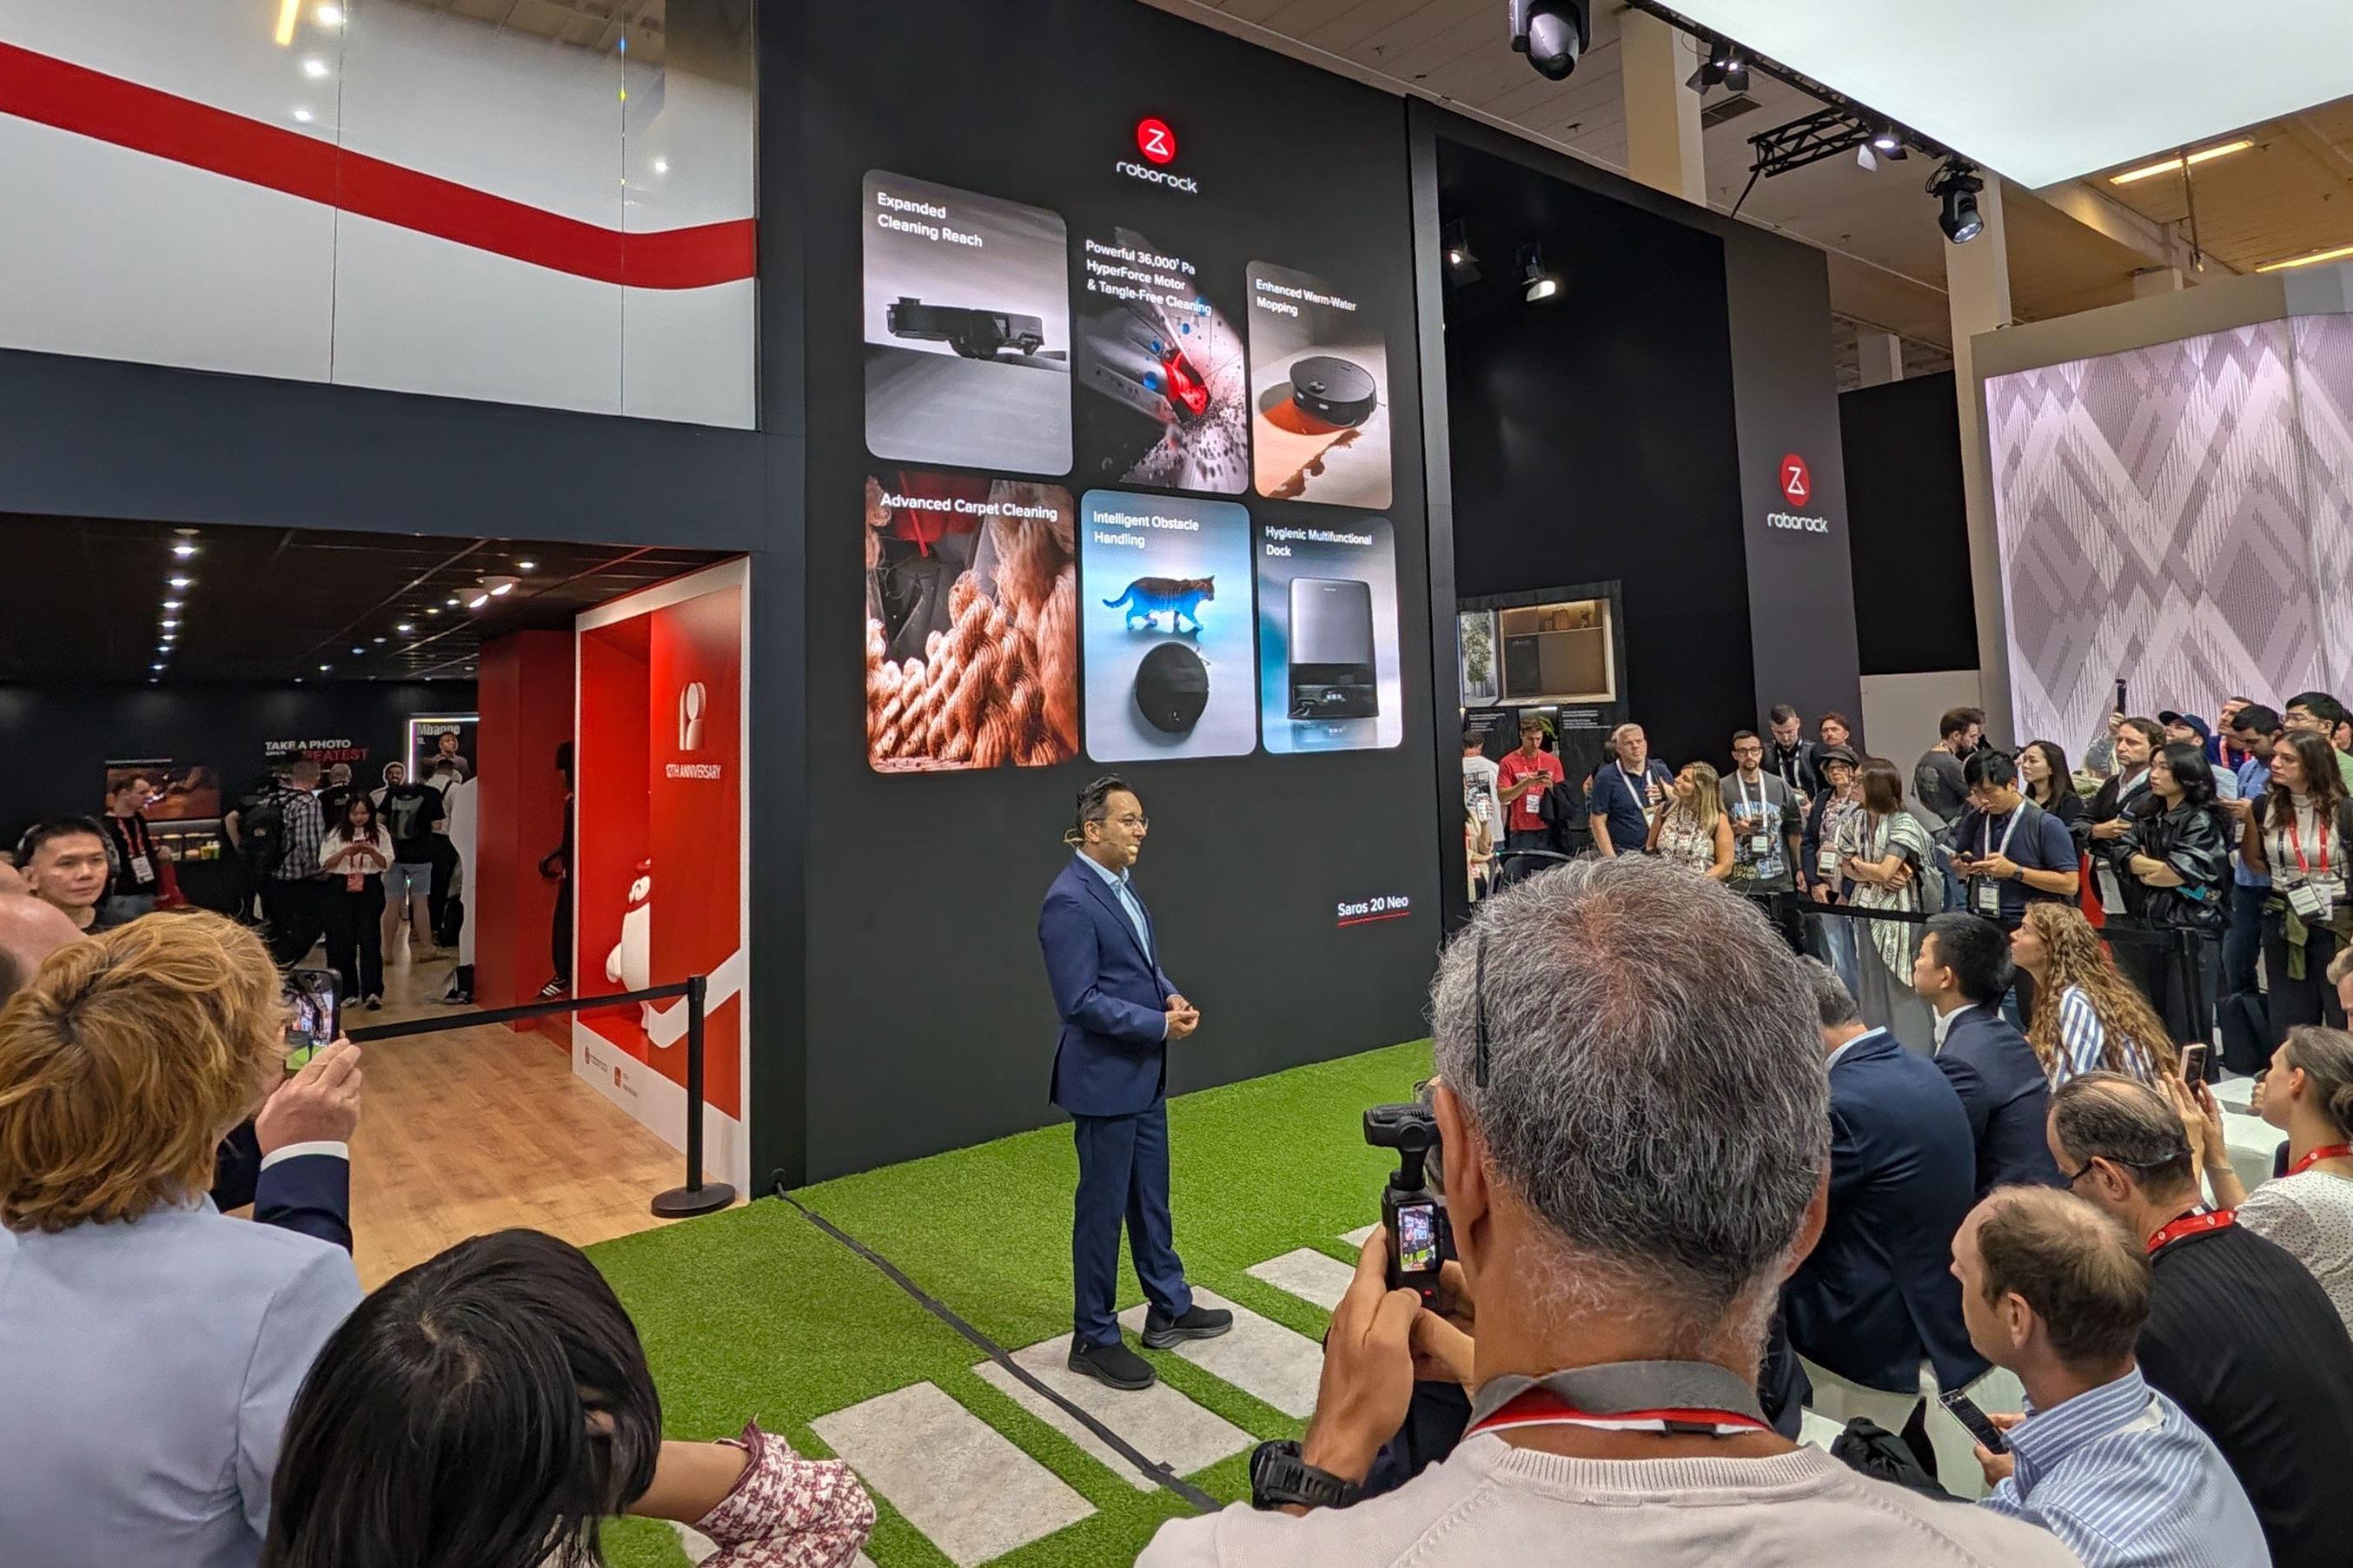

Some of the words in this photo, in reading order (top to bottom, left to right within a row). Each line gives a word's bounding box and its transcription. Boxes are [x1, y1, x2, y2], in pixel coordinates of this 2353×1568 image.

[1116, 161, 1198, 194] roborock
[877, 191, 946, 219] Expanded
[877, 214, 939, 241] Cleaning
[942, 228, 983, 248] Reach
[1086, 239, 1136, 261] Powerful
[1181, 261, 1196, 275] Pa
[1086, 259, 1152, 284] HyperForce
[1154, 274, 1186, 290] Motor
[1087, 279, 1097, 291] &
[1098, 280, 1163, 304] Tangle-Free
[1166, 294, 1212, 316] Cleaning
[1256, 278, 1302, 300] Enhanced
[1303, 289, 1357, 312] Warm-Water
[1256, 296, 1298, 317] Mopping
[880, 493, 951, 512] Advanced
[954, 499, 1000, 517] Carpet
[1002, 503, 1058, 521] Cleaning
[1093, 510, 1150, 528] Intelligent
[1151, 515, 1199, 532] Obstacle
[1766, 512, 1829, 533] roborock
[1094, 531, 1145, 548] Handling
[1265, 525, 1306, 540] Hygienic
[1308, 529, 1373, 546] Multifunctional
[1266, 544, 1292, 557] Dock
[265, 740, 295, 751] TAKE
[298, 740, 308, 750] A
[309, 739, 352, 750] PHOTO
[1337, 903, 1369, 916] Saros
[1370, 896, 1385, 912] 20
[1387, 896, 1409, 910] Neo
